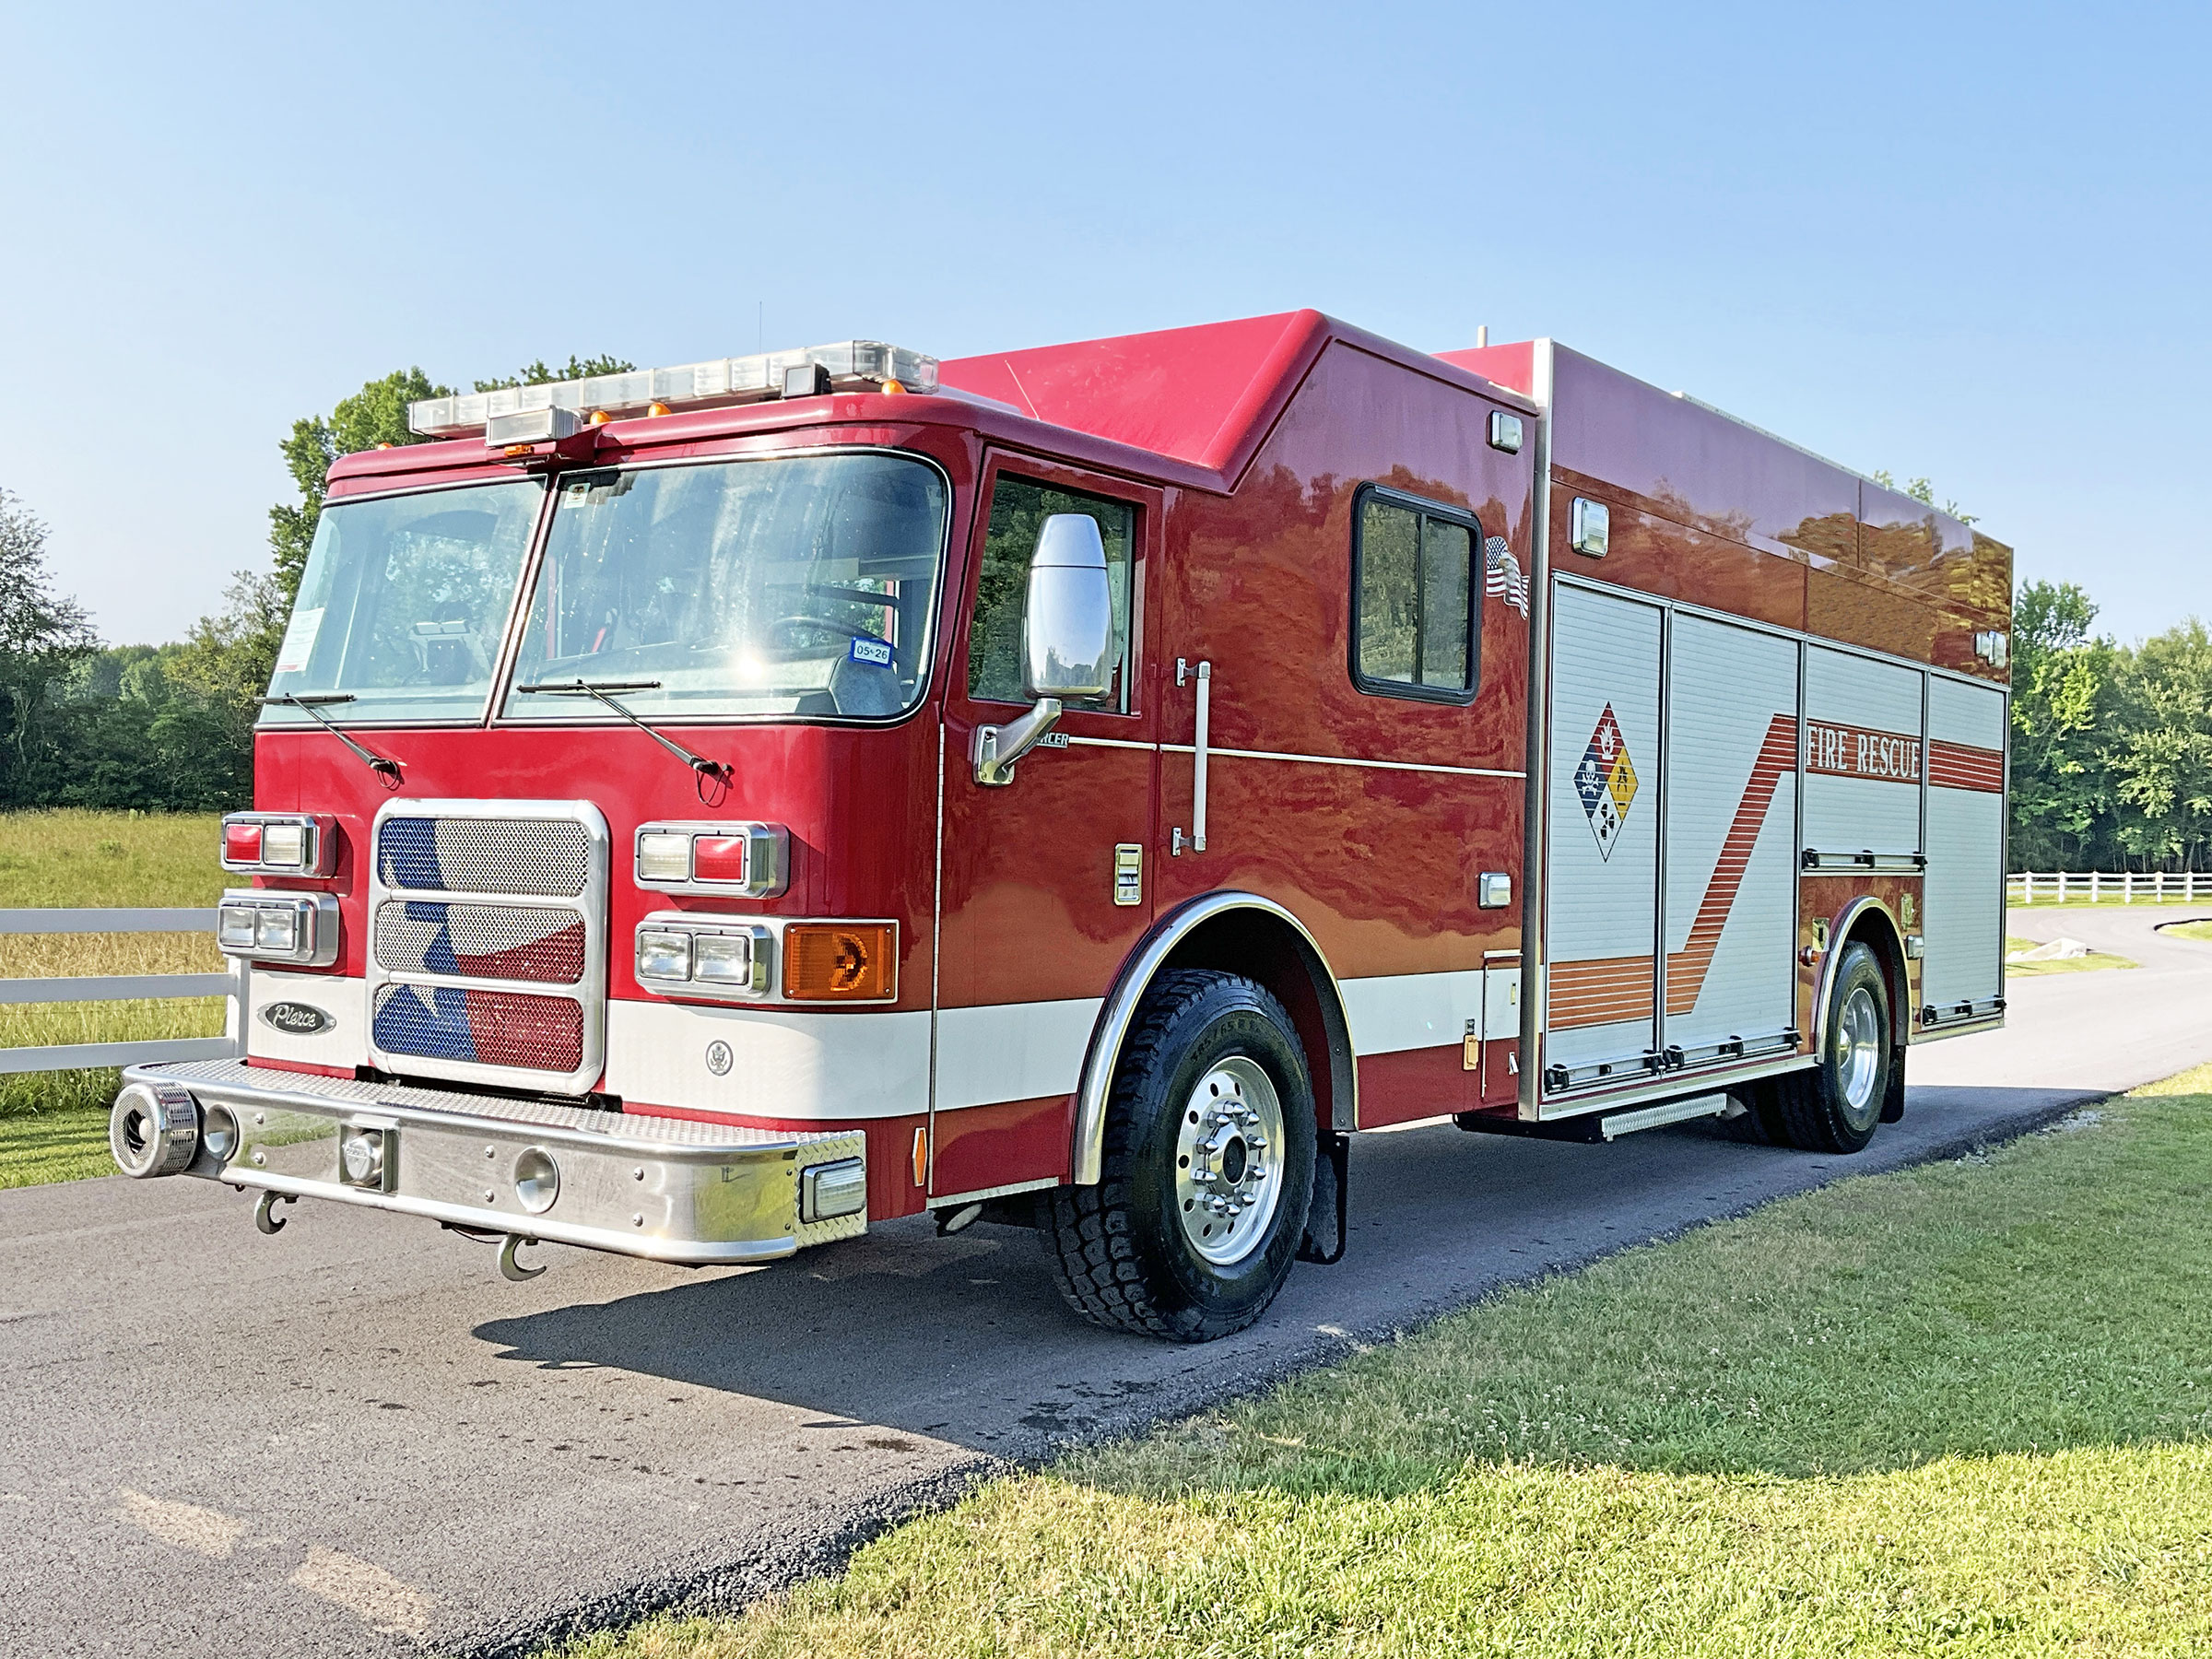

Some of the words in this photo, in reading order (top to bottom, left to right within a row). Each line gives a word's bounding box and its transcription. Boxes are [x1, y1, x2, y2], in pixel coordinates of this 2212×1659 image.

[1806, 725, 1848, 771] FIRE
[1856, 734, 1921, 779] RESCUE
[273, 1004, 316, 1028] Pierce
